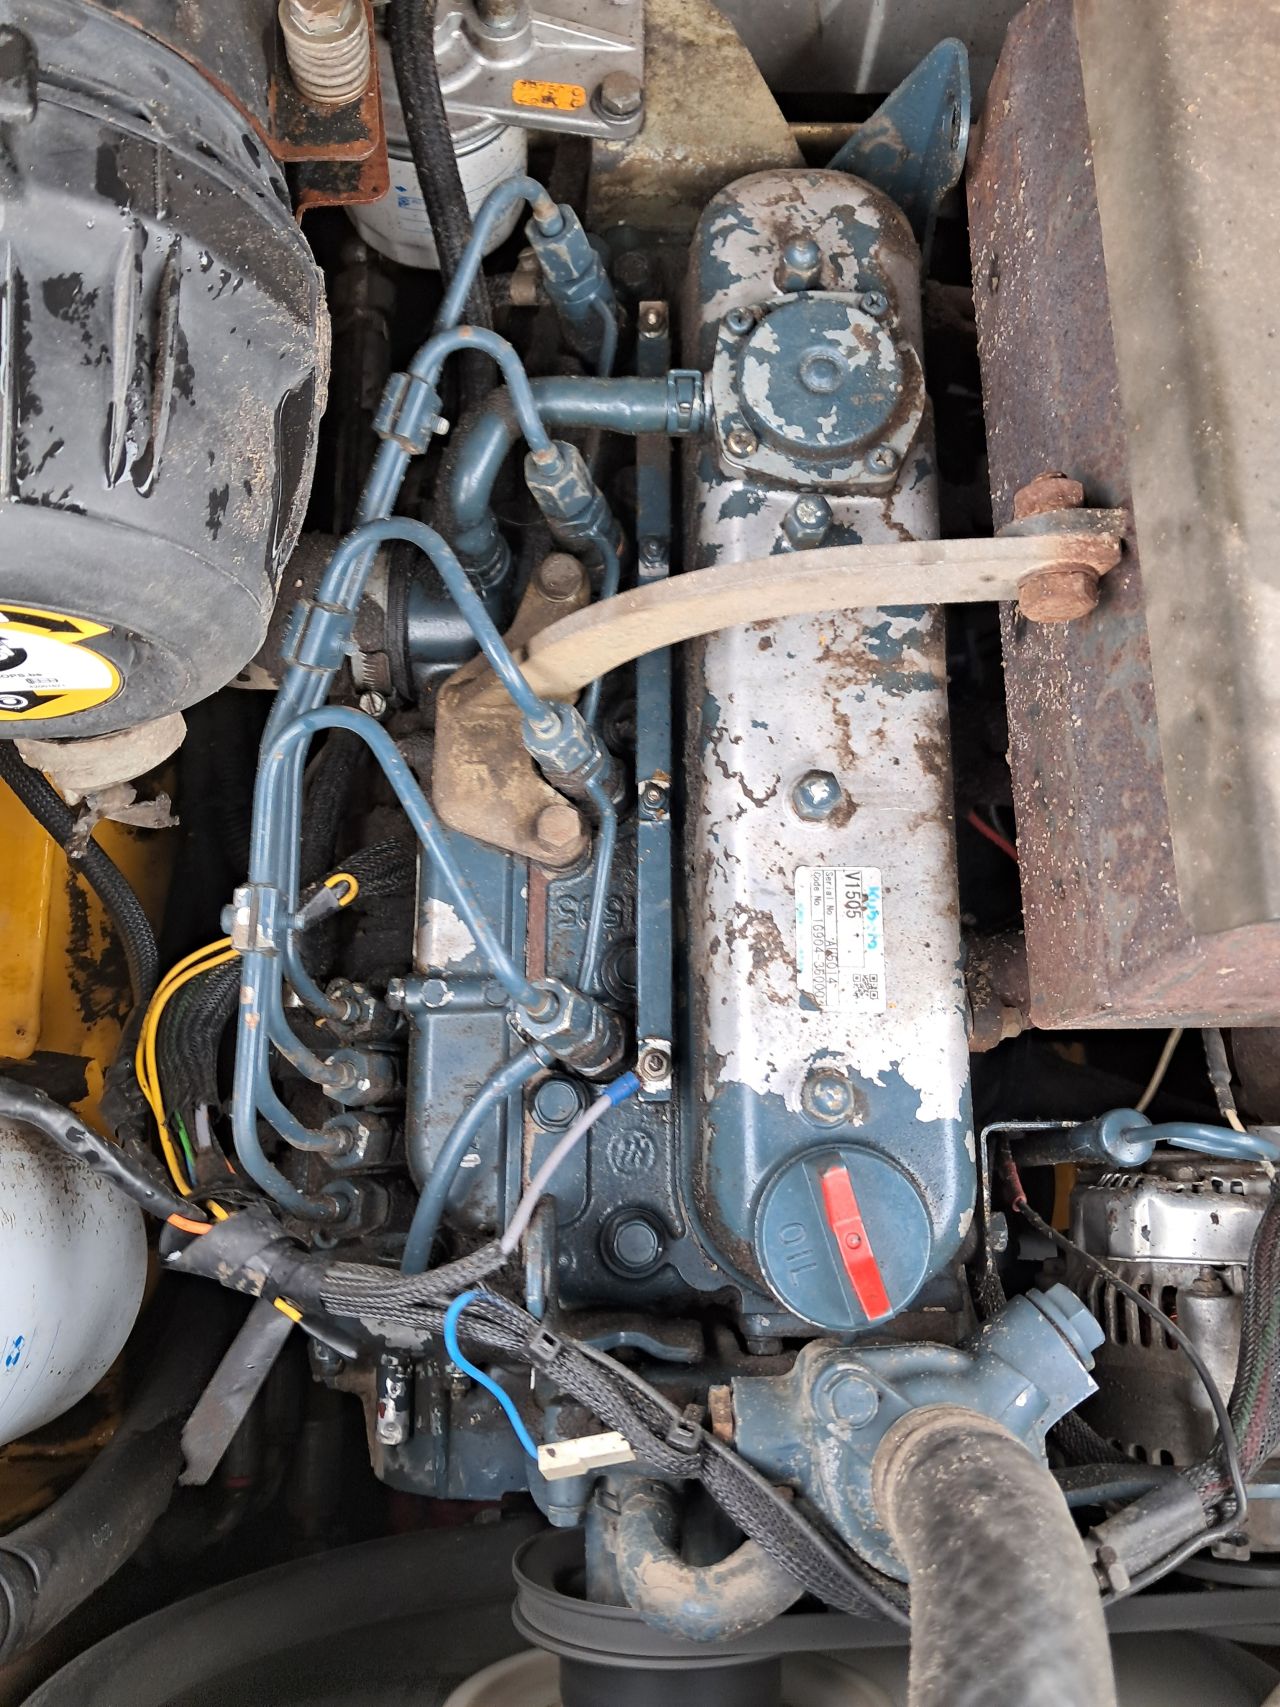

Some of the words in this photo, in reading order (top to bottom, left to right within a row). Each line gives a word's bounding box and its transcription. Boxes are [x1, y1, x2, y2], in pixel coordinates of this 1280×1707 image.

[813, 871, 821, 891] Code
[825, 871, 834, 900] Serial
[814, 895, 822, 906] No
[845, 871, 862, 919] V1505
[826, 905, 835, 916] No
[779, 1223, 817, 1287] OIL
